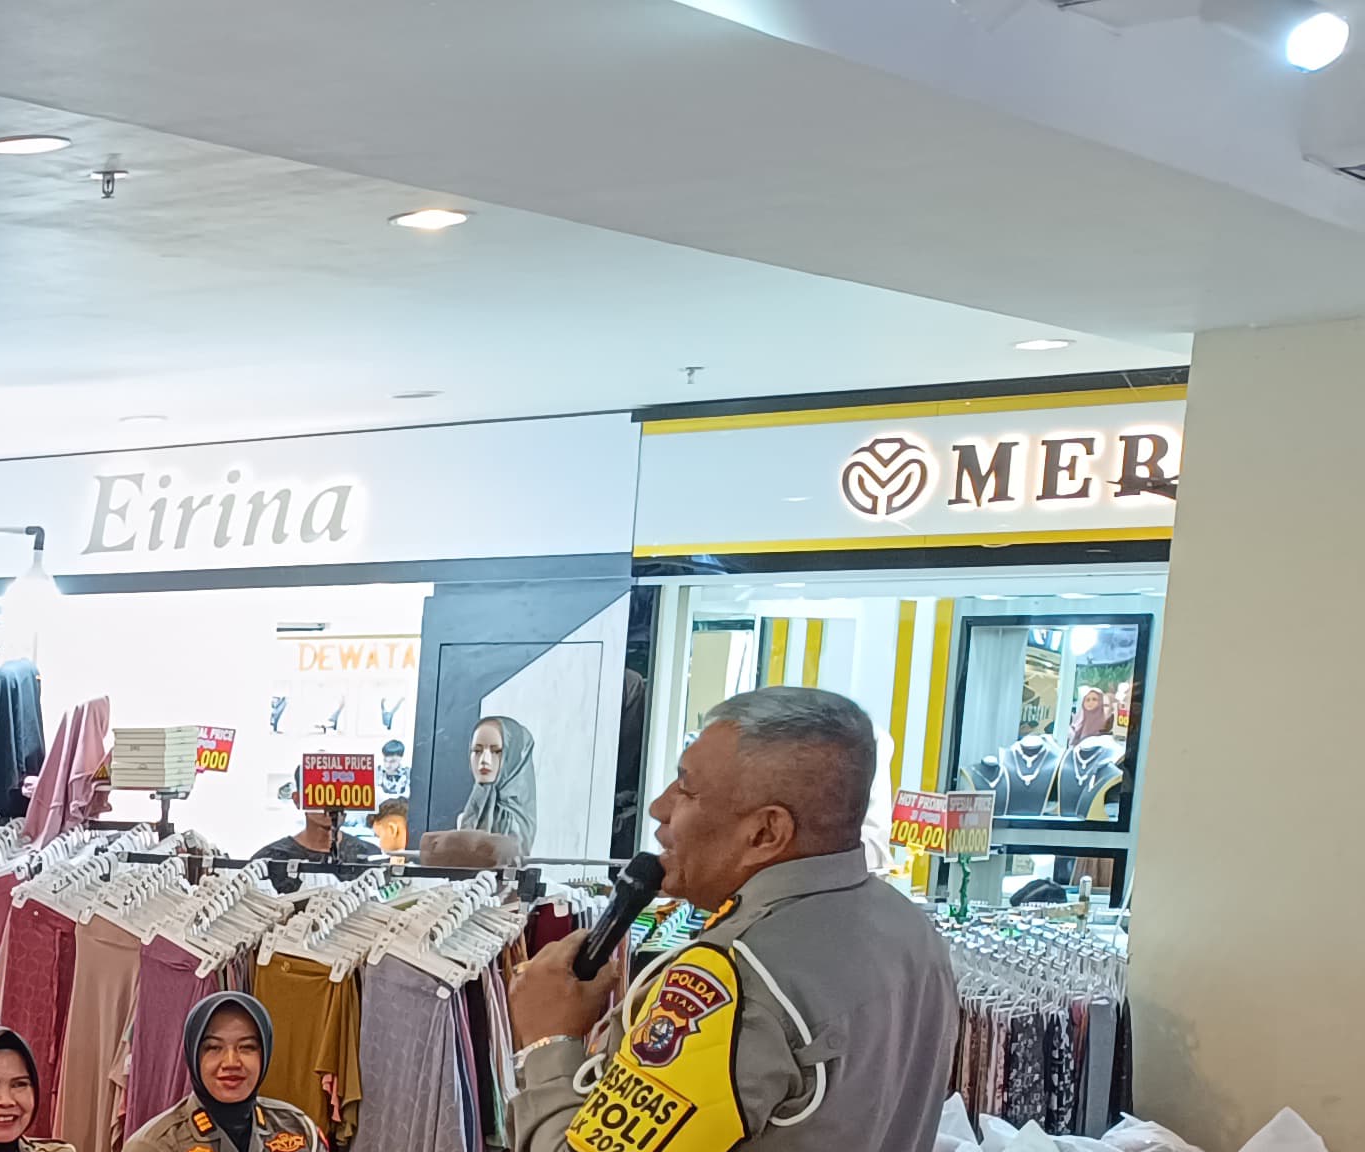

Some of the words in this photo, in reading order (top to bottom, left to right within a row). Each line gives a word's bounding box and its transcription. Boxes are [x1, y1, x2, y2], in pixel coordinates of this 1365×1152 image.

[80, 469, 353, 556] Eirina
[298, 642, 416, 671] DEWATA
[304, 756, 343, 770] SPESIAL
[344, 756, 373, 770] PRICE
[304, 784, 373, 807] 100.000
[917, 794, 946, 812] PROM
[668, 972, 716, 1004] POLDA
[665, 993, 696, 1012] RIAU
[601, 1063, 678, 1125] ASATGAS
